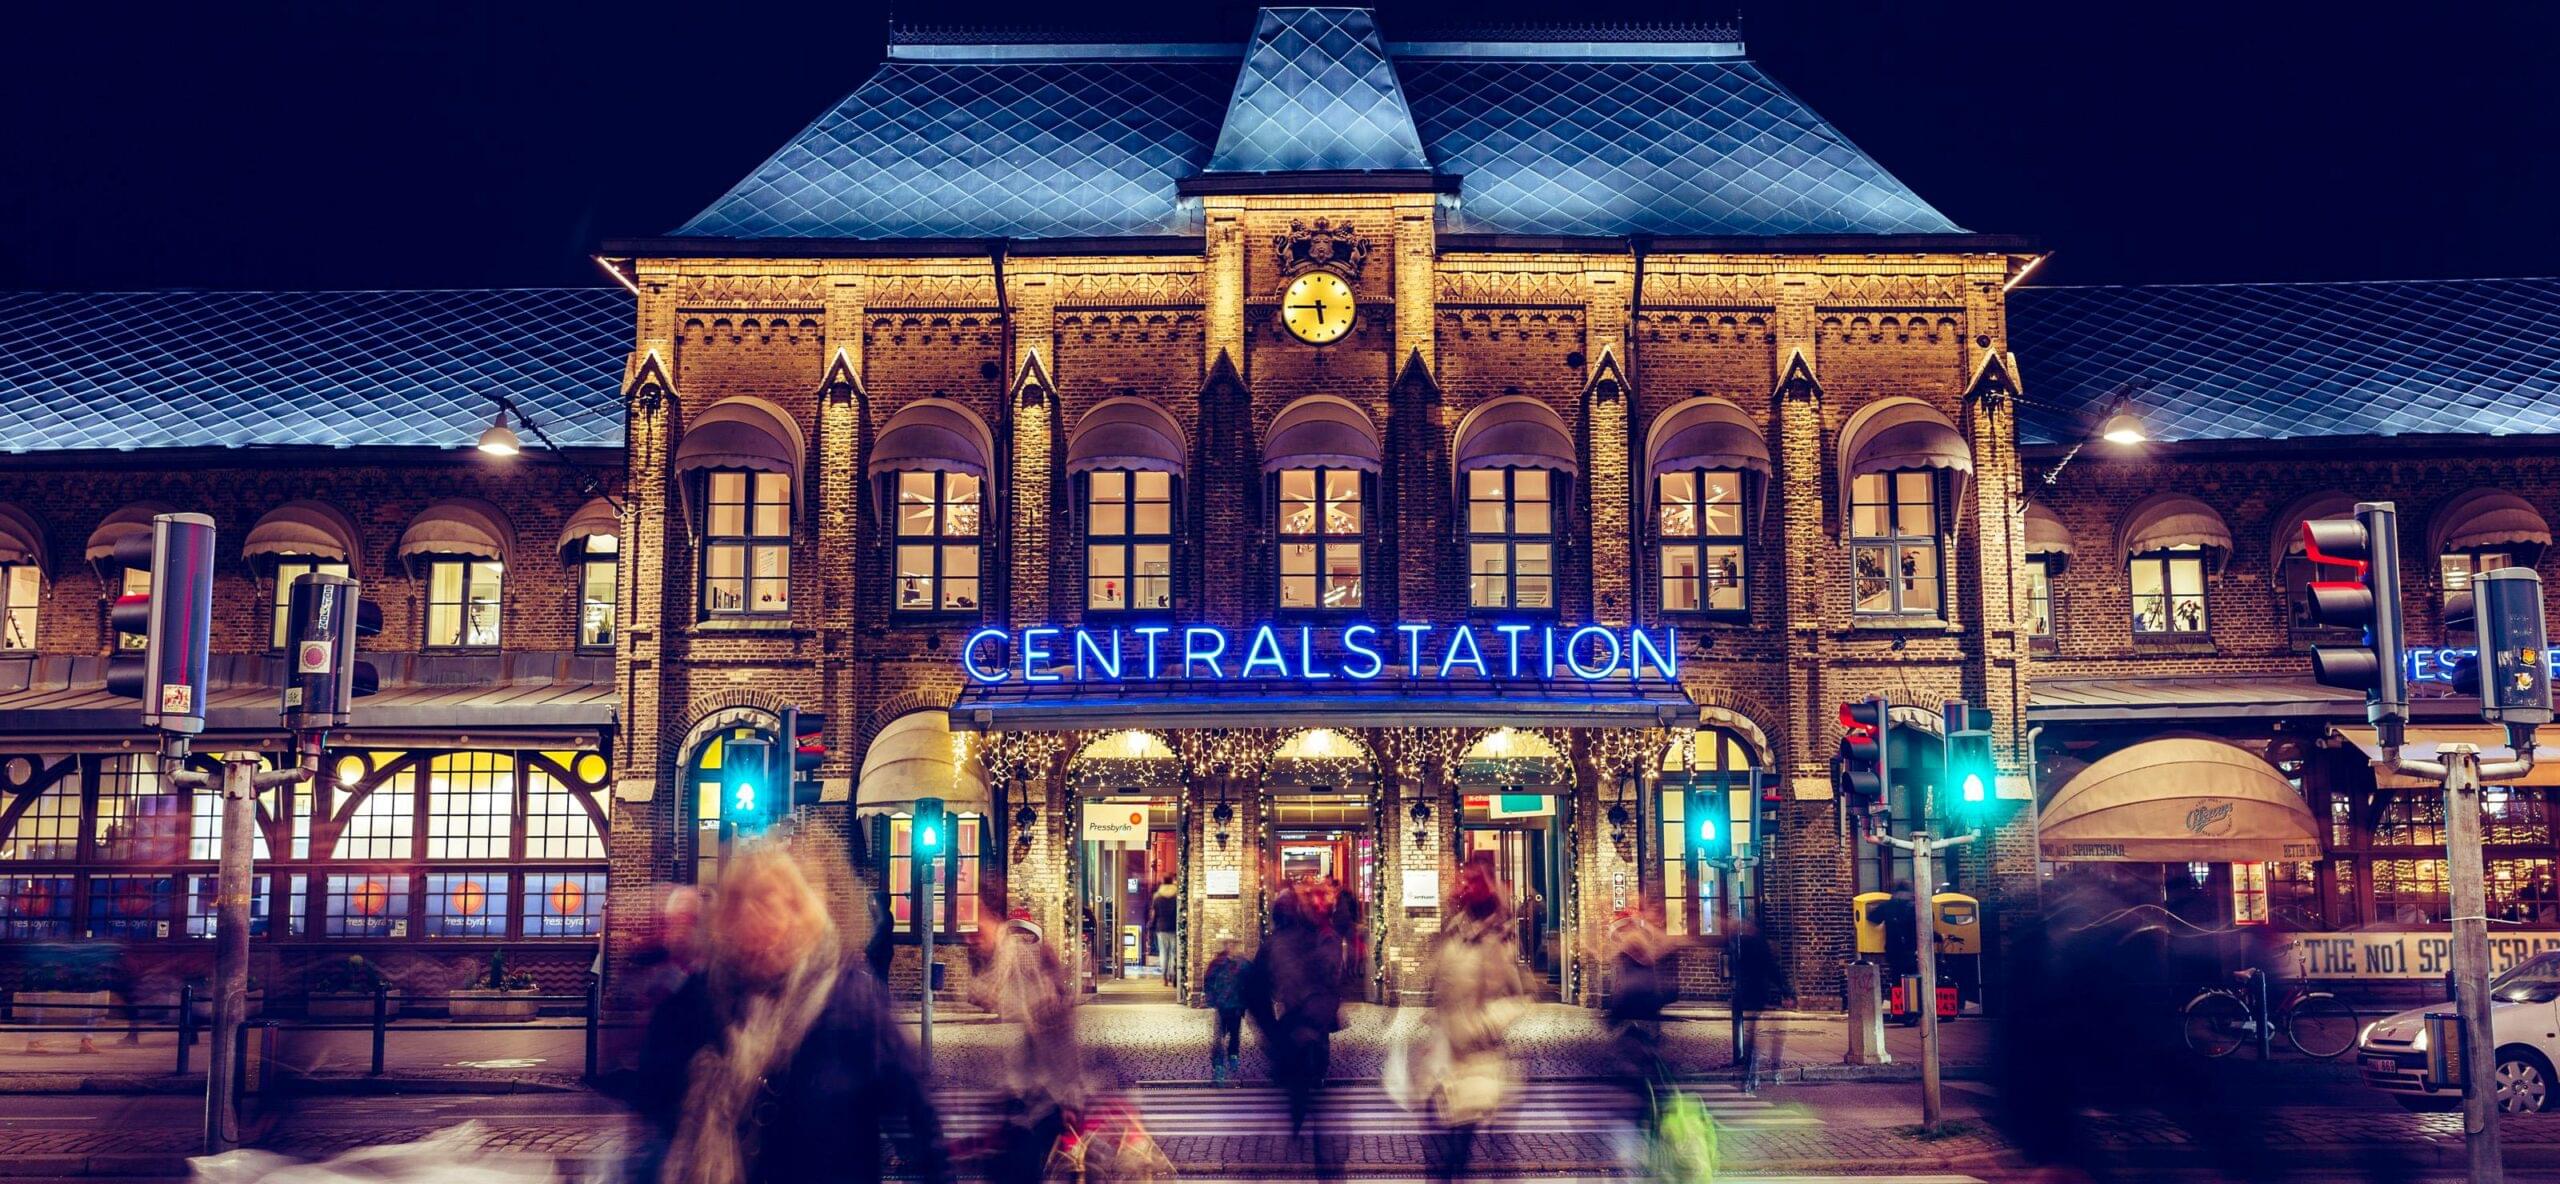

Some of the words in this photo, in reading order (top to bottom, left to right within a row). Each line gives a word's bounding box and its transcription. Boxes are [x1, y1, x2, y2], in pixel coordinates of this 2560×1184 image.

[963, 624, 1679, 683] CENTRALSTATION
[1089, 822, 1132, 833] Pressbyrån
[2072, 843, 2125, 857] SPORTSBAR
[2304, 938, 2357, 974] THE
